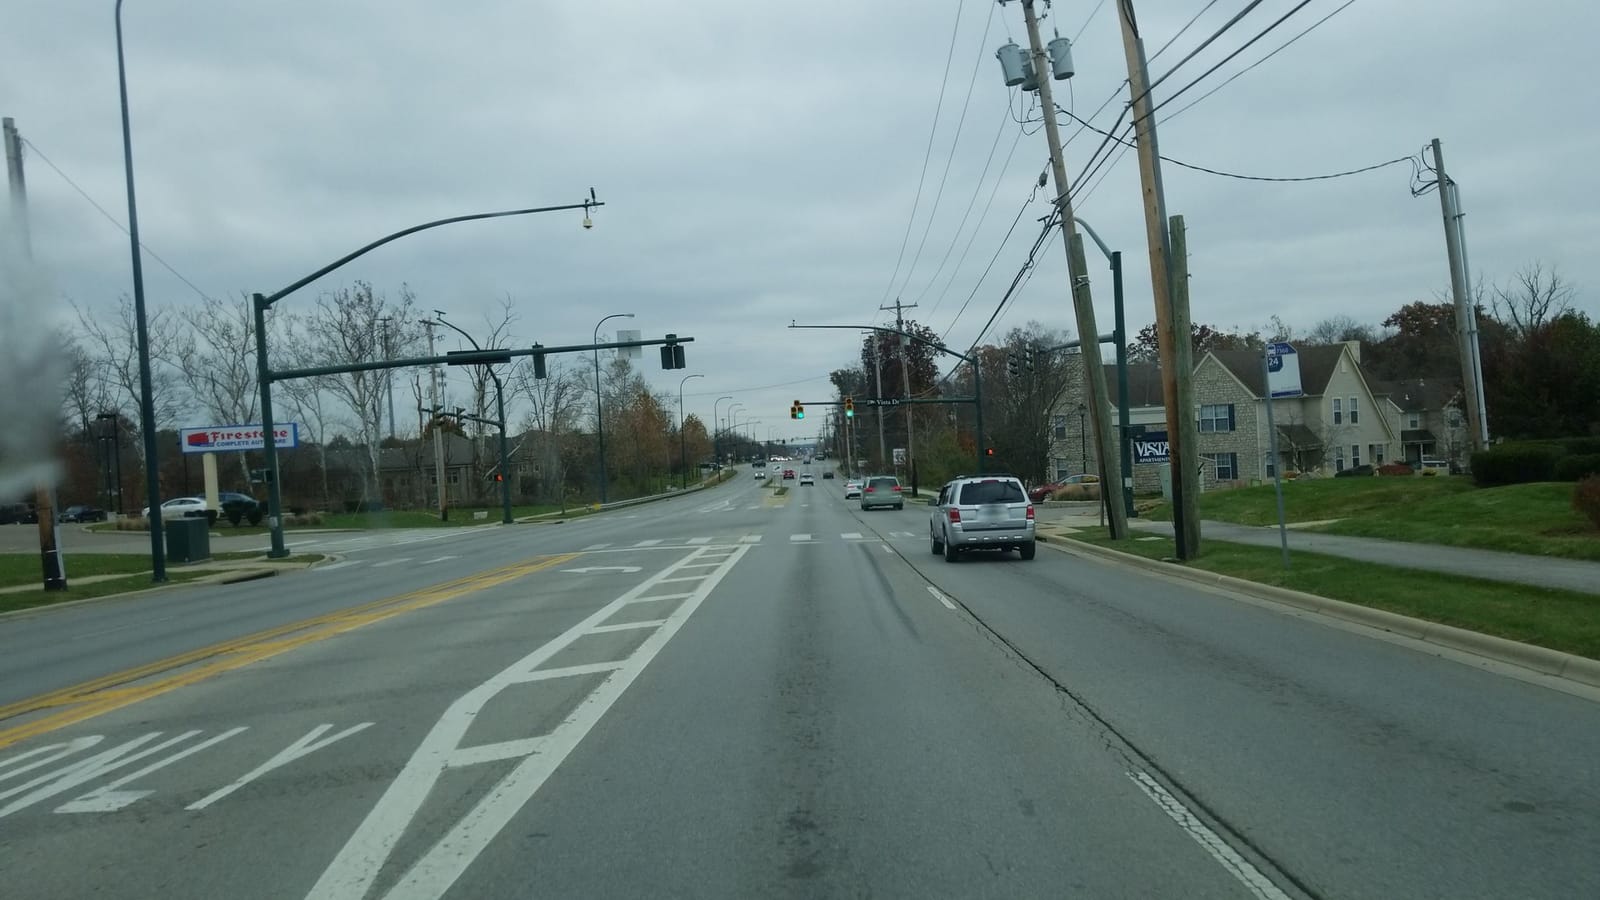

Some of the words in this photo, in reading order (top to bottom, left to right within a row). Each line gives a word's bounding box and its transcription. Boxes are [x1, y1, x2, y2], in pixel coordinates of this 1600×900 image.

[1268, 356, 1279, 365] 24
[216, 440, 249, 448] COMPLETE
[1134, 441, 1169, 457] VISTA
